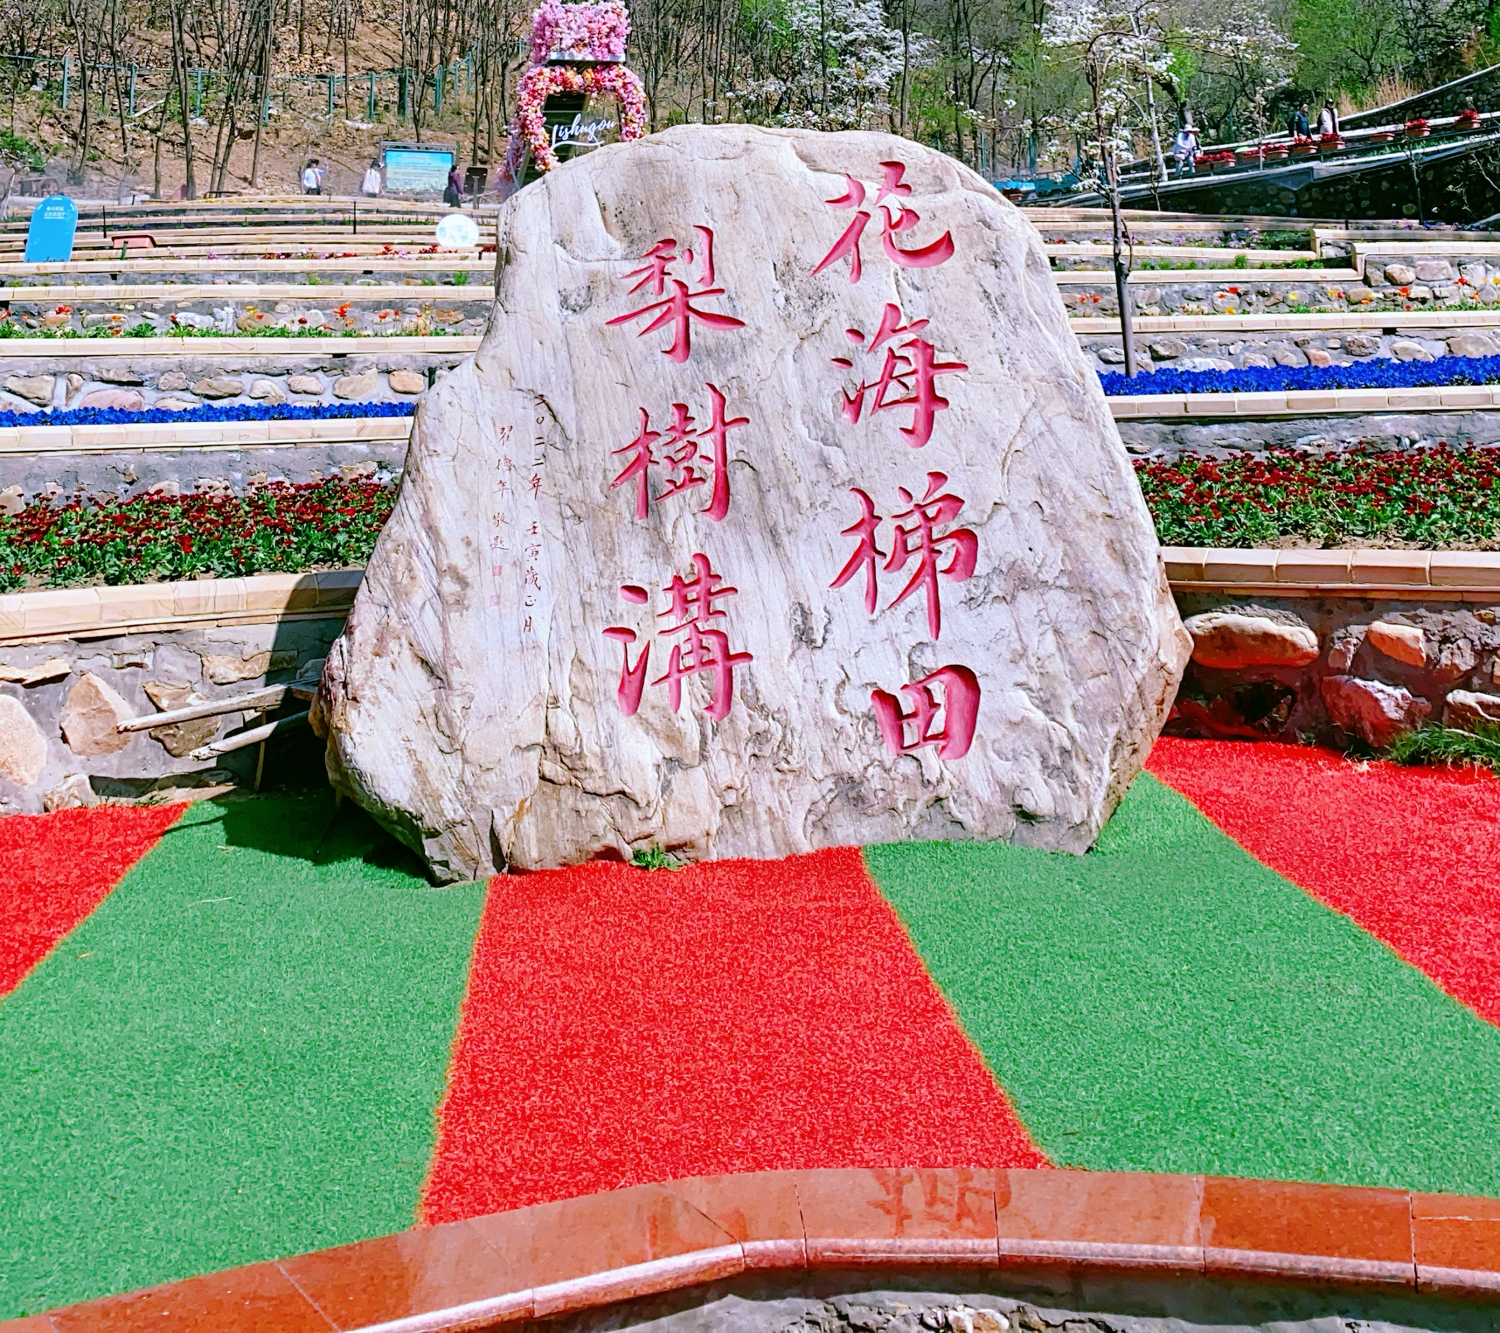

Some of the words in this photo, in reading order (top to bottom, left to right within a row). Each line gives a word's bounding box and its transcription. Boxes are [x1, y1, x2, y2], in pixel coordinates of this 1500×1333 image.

[602, 225, 753, 723] 梨樹溝
[811, 161, 980, 760] 花海梯田
